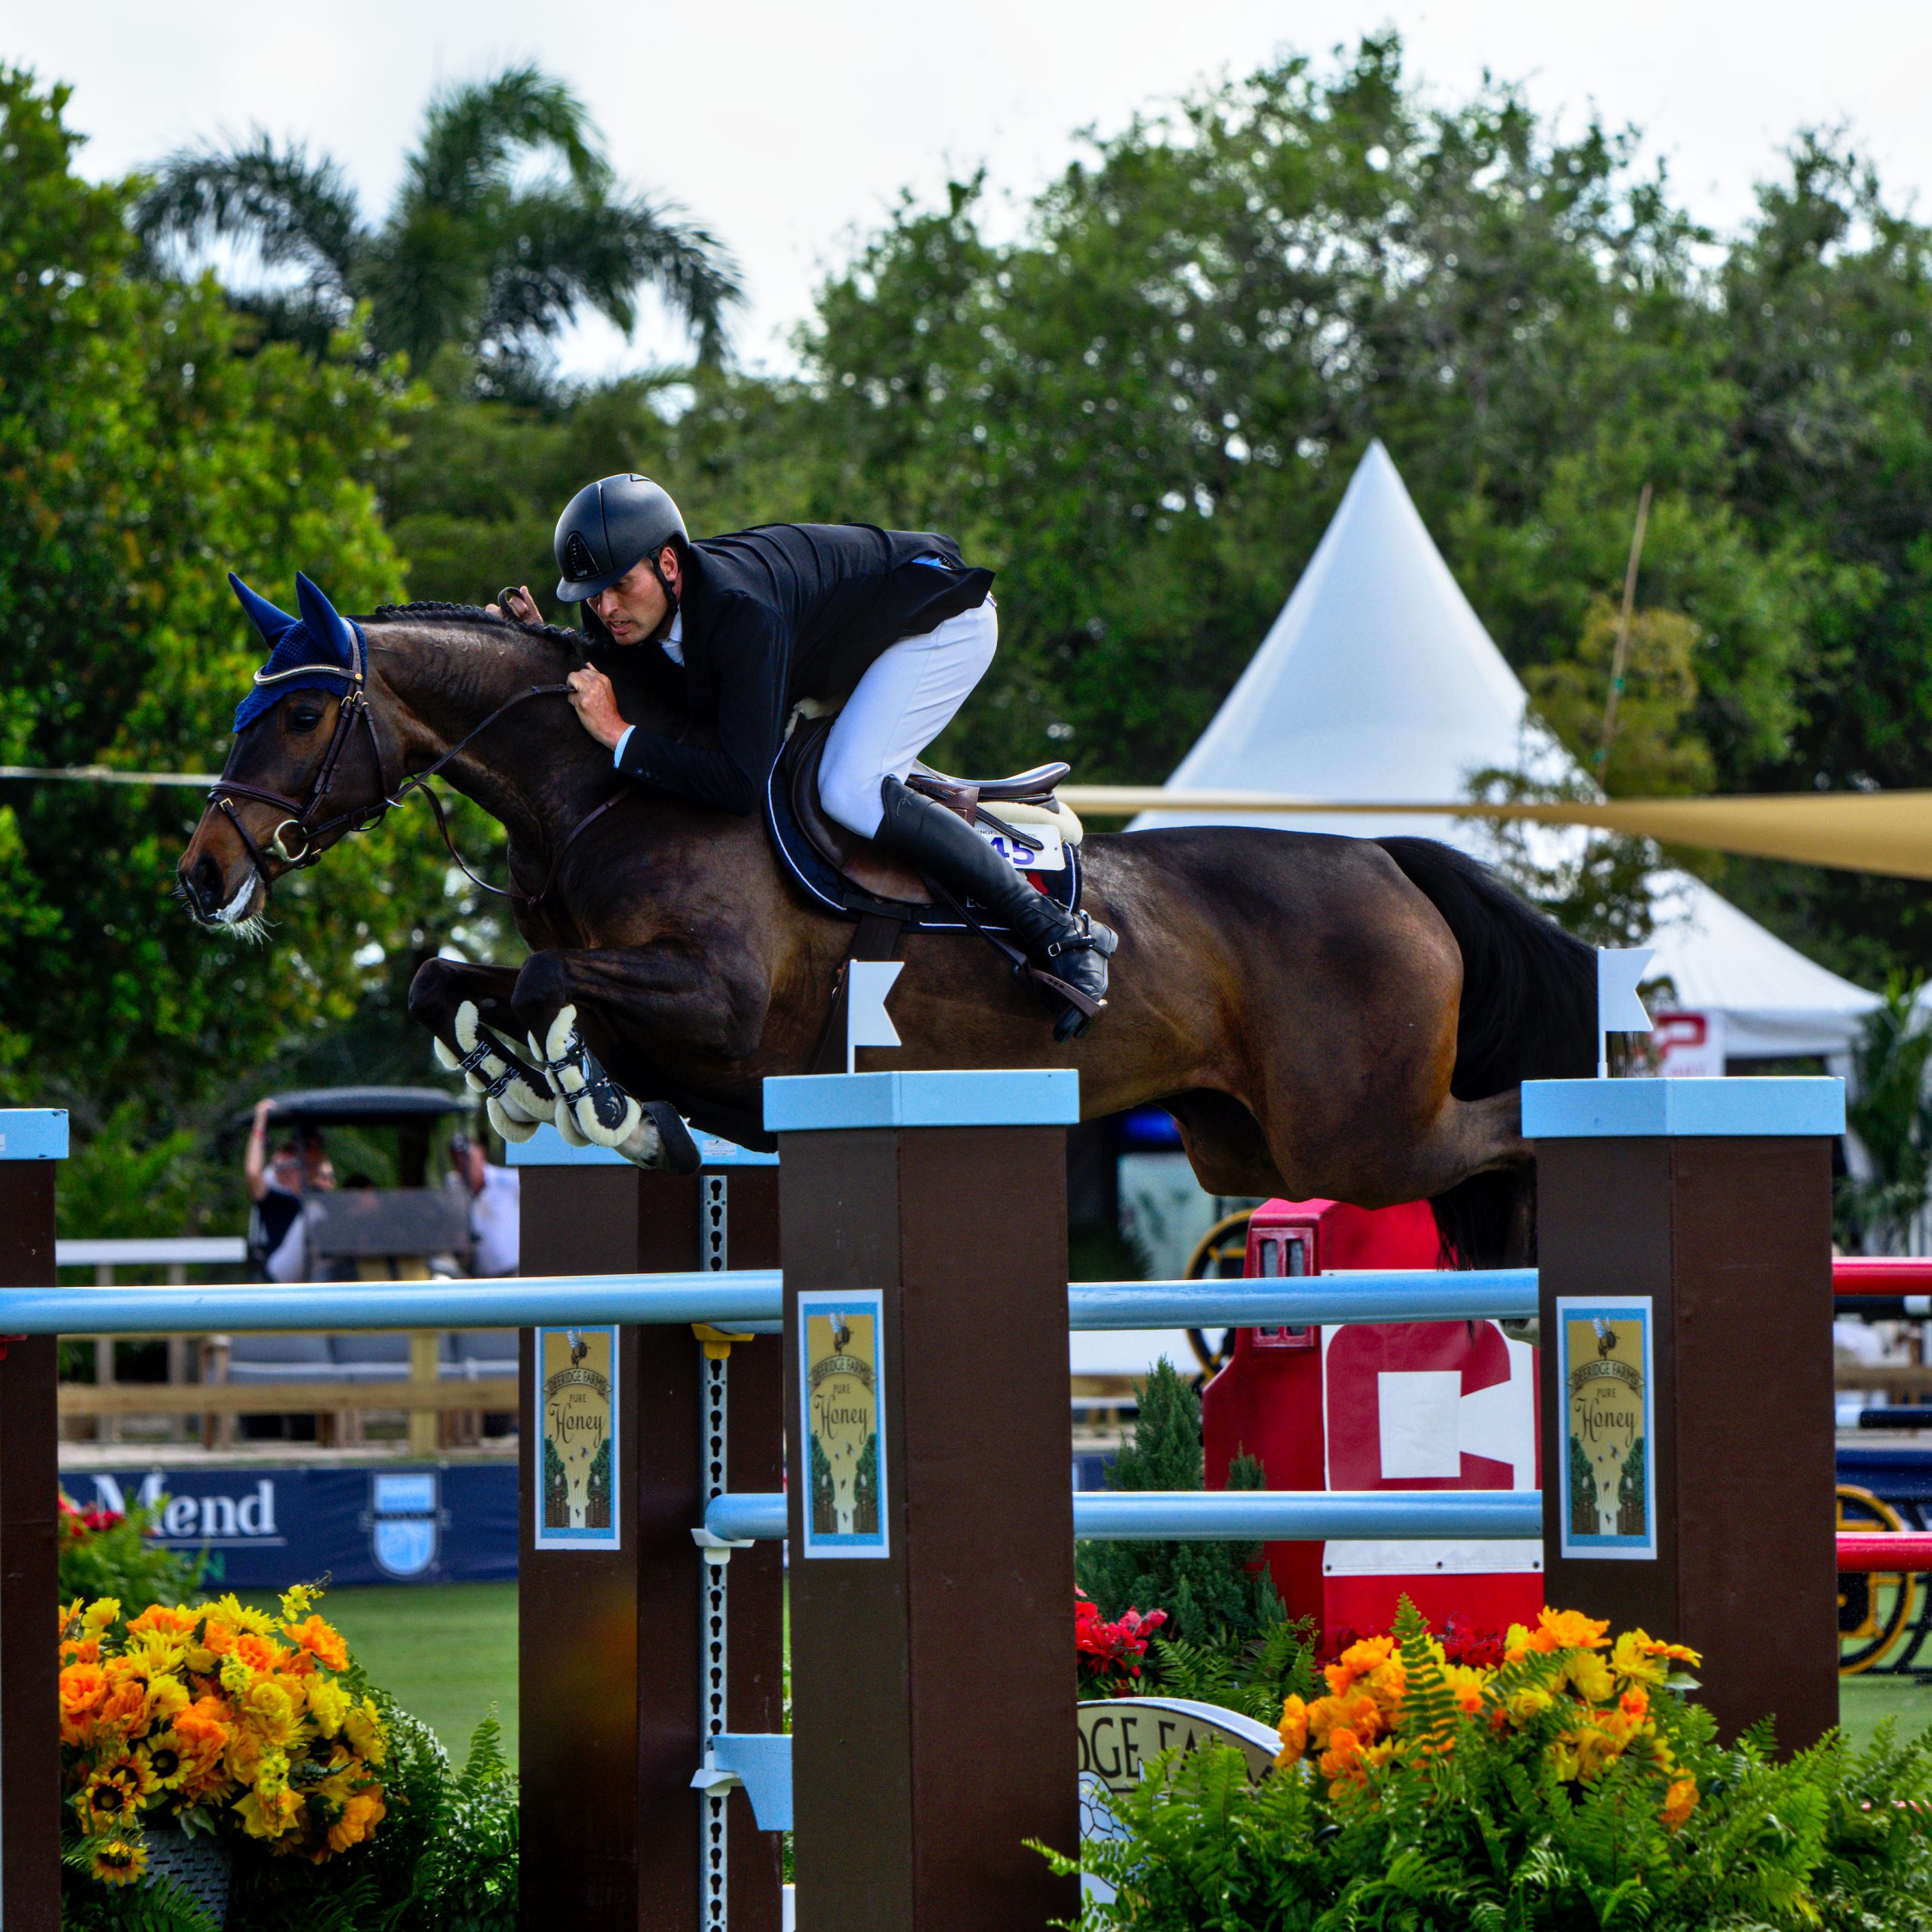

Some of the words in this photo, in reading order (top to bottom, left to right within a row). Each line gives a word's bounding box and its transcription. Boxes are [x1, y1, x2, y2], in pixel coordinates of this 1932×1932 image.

[812, 1358, 844, 1380] DEERIDGE
[848, 1358, 871, 1380] FARMS
[1574, 1362, 1610, 1385] DEERIDGE
[1613, 1363, 1638, 1385] FARMS
[549, 1370, 581, 1392] DEERIDGE
[583, 1371, 607, 1391] FARMS
[833, 1383, 851, 1394] PURE
[569, 1393, 586, 1403] PURE
[1596, 1388, 1617, 1398] PURE
[549, 1402, 604, 1448] Honey
[814, 1393, 869, 1444] Honey
[1574, 1397, 1636, 1447] Honey
[91, 1472, 278, 1537] Mend
